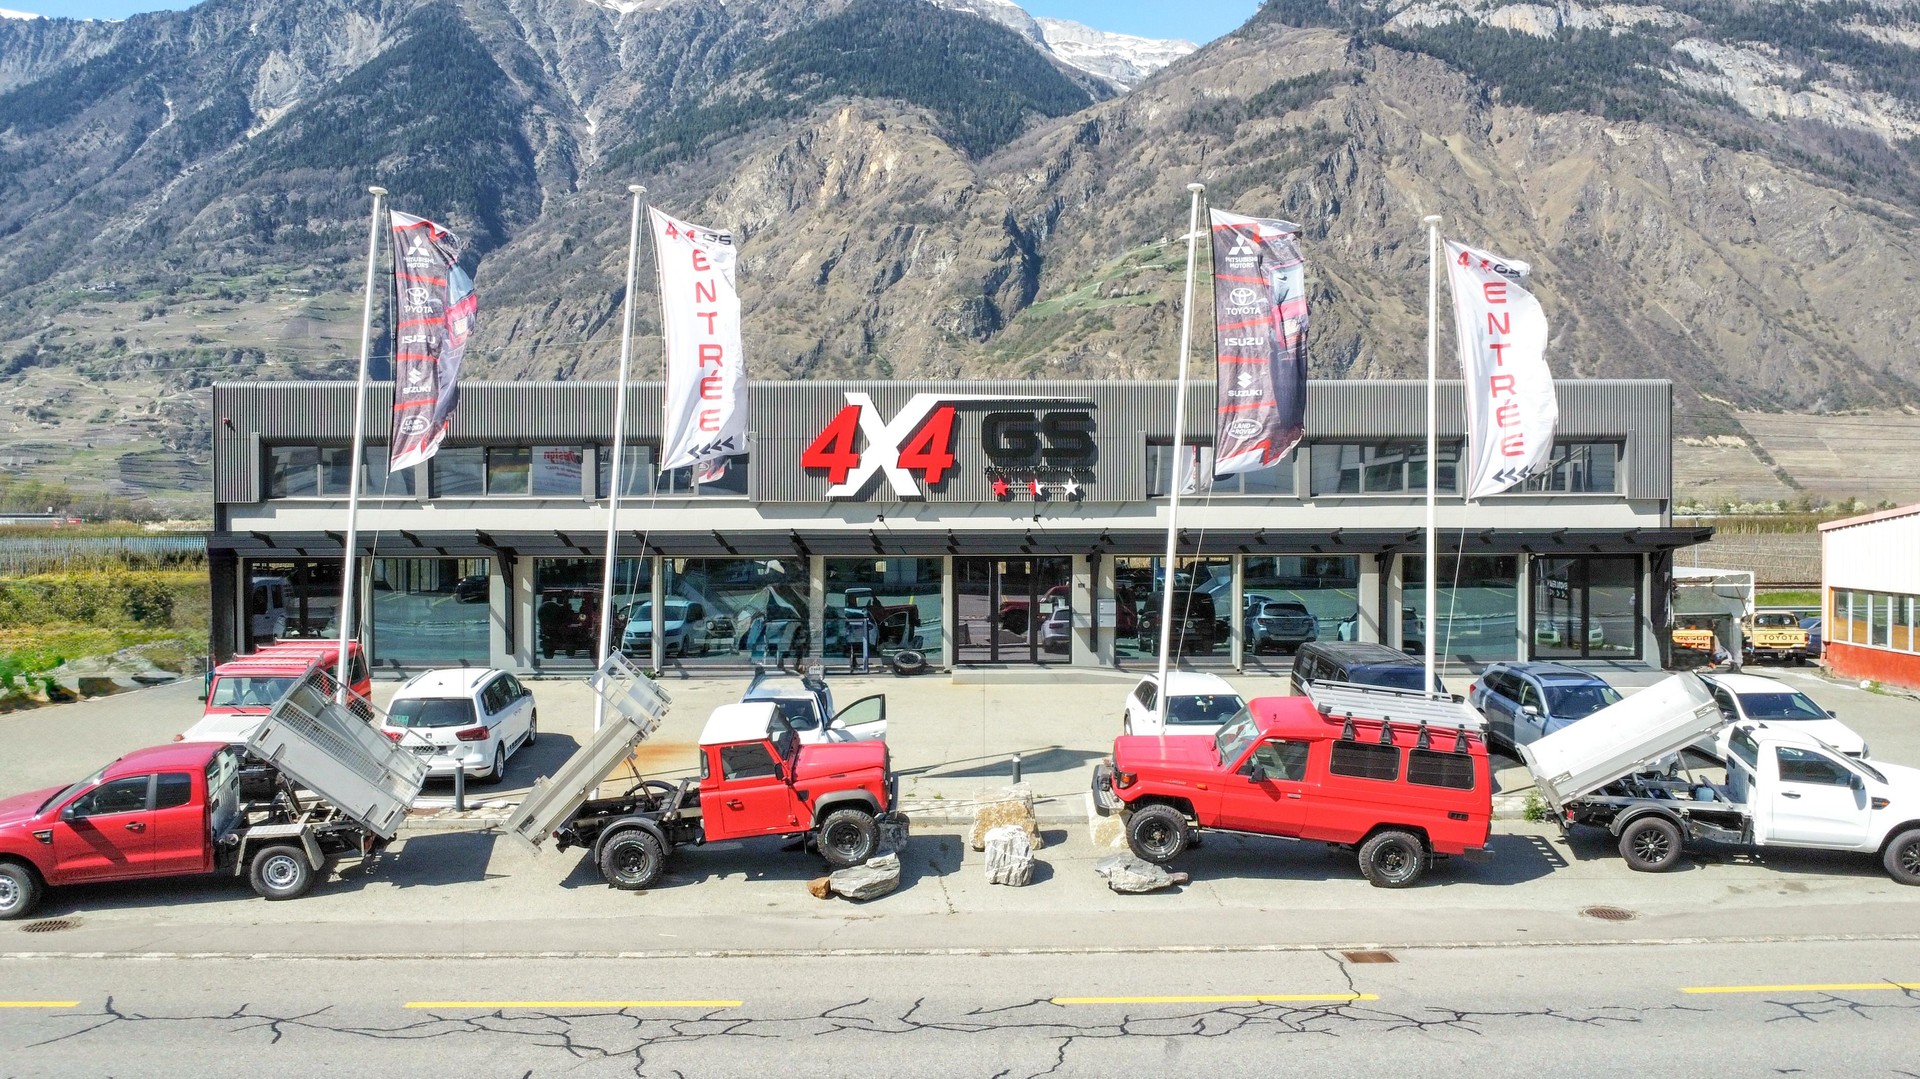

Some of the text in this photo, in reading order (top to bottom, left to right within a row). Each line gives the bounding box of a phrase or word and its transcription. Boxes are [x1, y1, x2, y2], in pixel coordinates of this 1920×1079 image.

[1225, 307, 1261, 315] TOYOTA
[1224, 337, 1264, 347] ISUZU
[1227, 389, 1263, 397] SUZUKI
[981, 411, 1093, 458] GS
